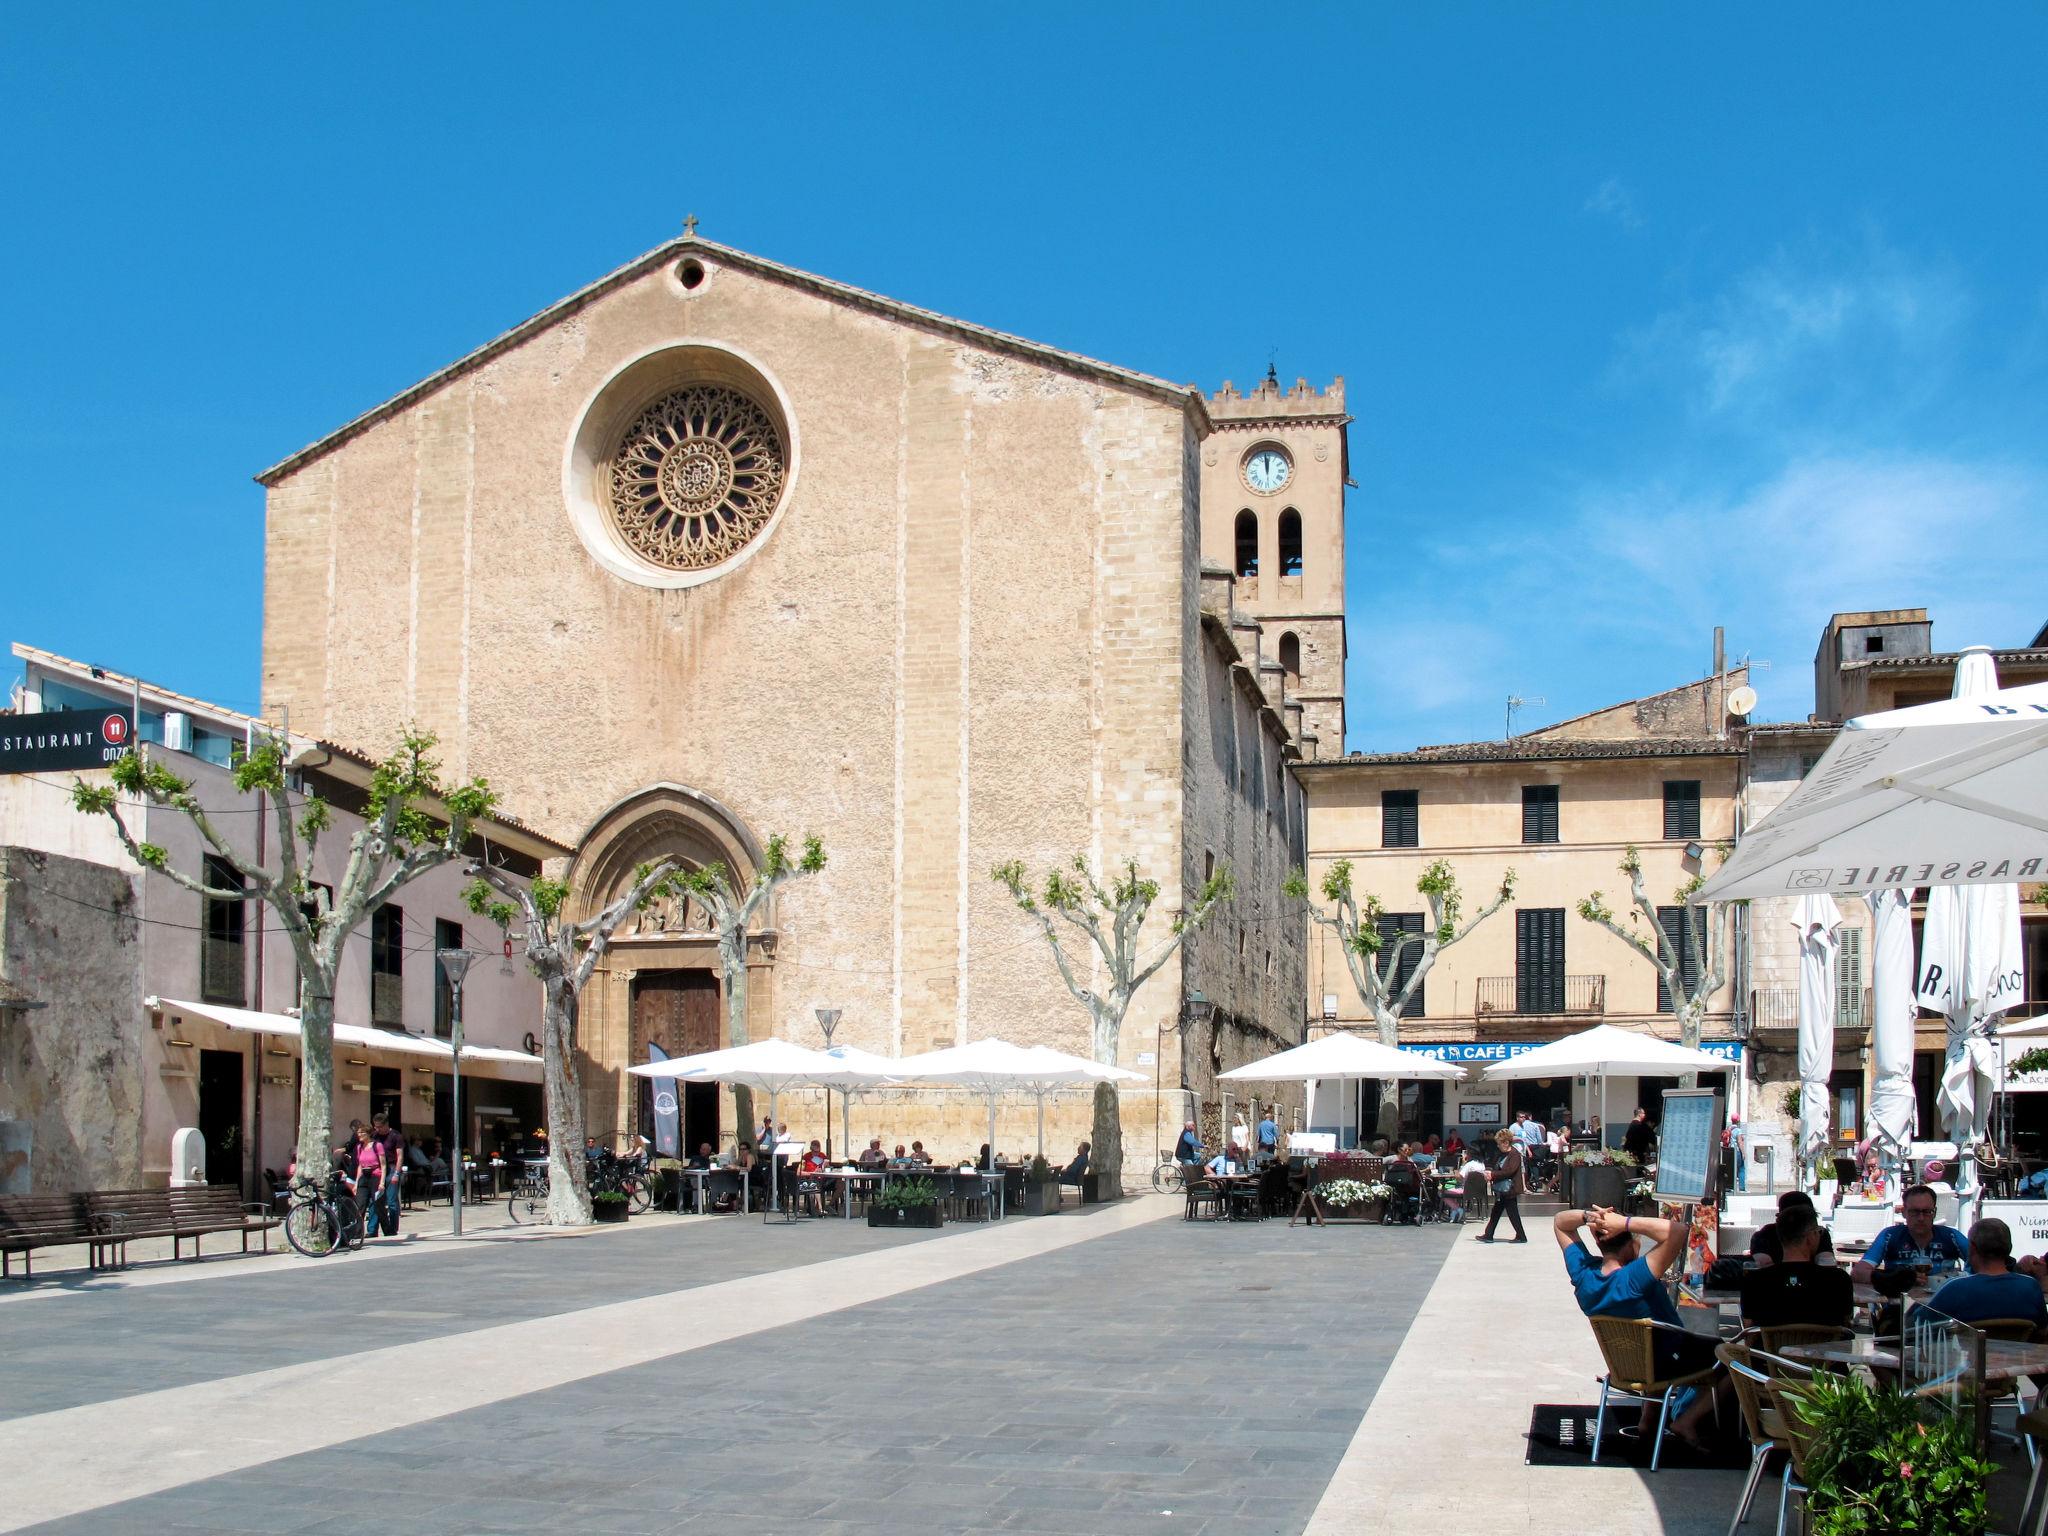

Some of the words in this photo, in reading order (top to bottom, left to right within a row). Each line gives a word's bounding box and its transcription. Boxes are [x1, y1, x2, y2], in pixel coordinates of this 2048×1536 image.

[1979, 705, 2048, 715] B
[110, 723, 120, 735] 11
[4, 732, 93, 751] STAURANT
[1463, 1045, 1506, 1059] CAFÉ
